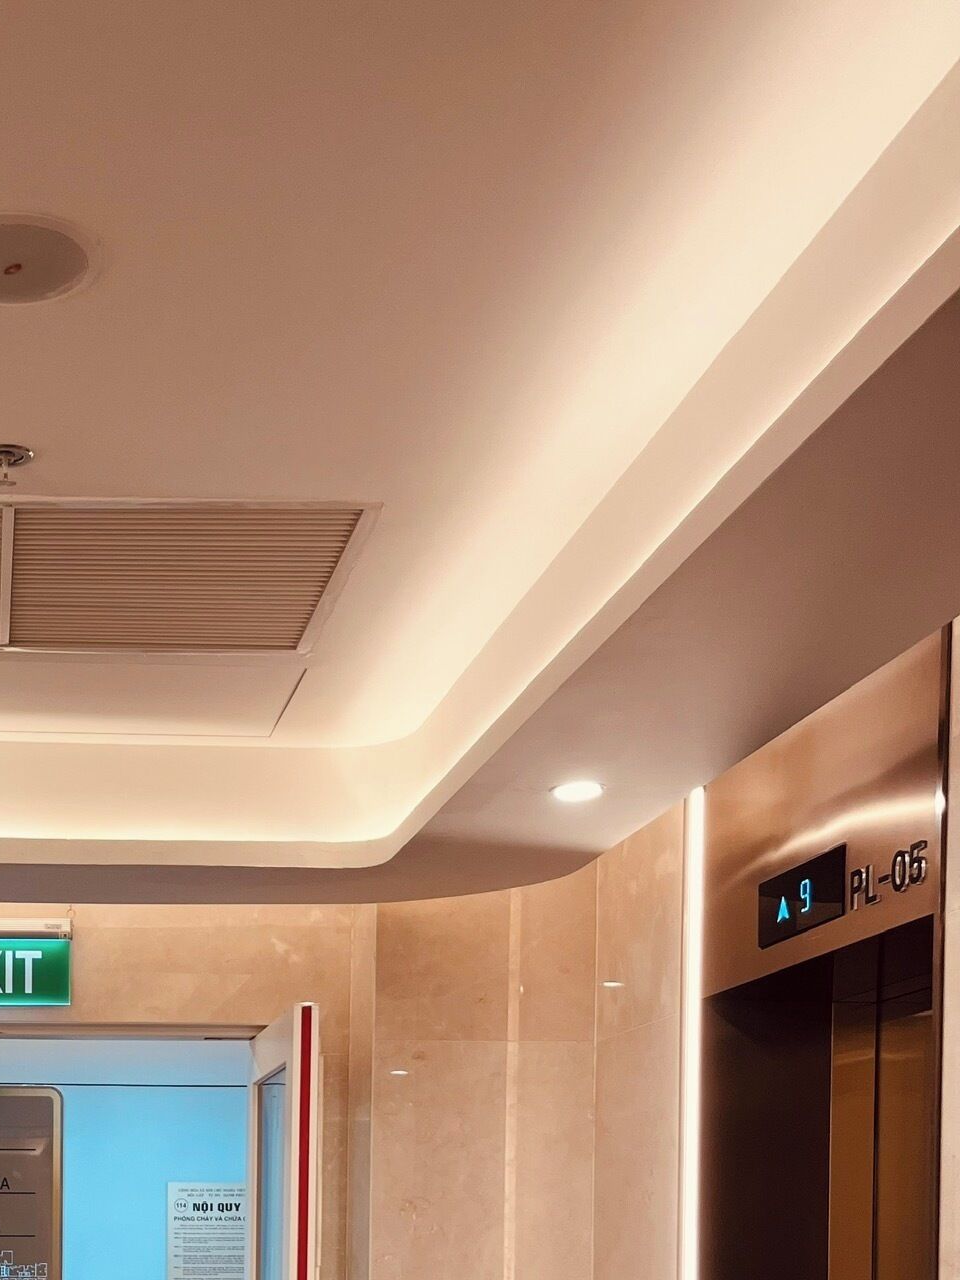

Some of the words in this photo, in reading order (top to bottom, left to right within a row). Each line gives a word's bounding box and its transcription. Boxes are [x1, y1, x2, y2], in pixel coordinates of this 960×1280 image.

[800, 878, 811, 913] 9
[192, 1200, 213, 1213] NỘI
[217, 1202, 241, 1213] QUY
